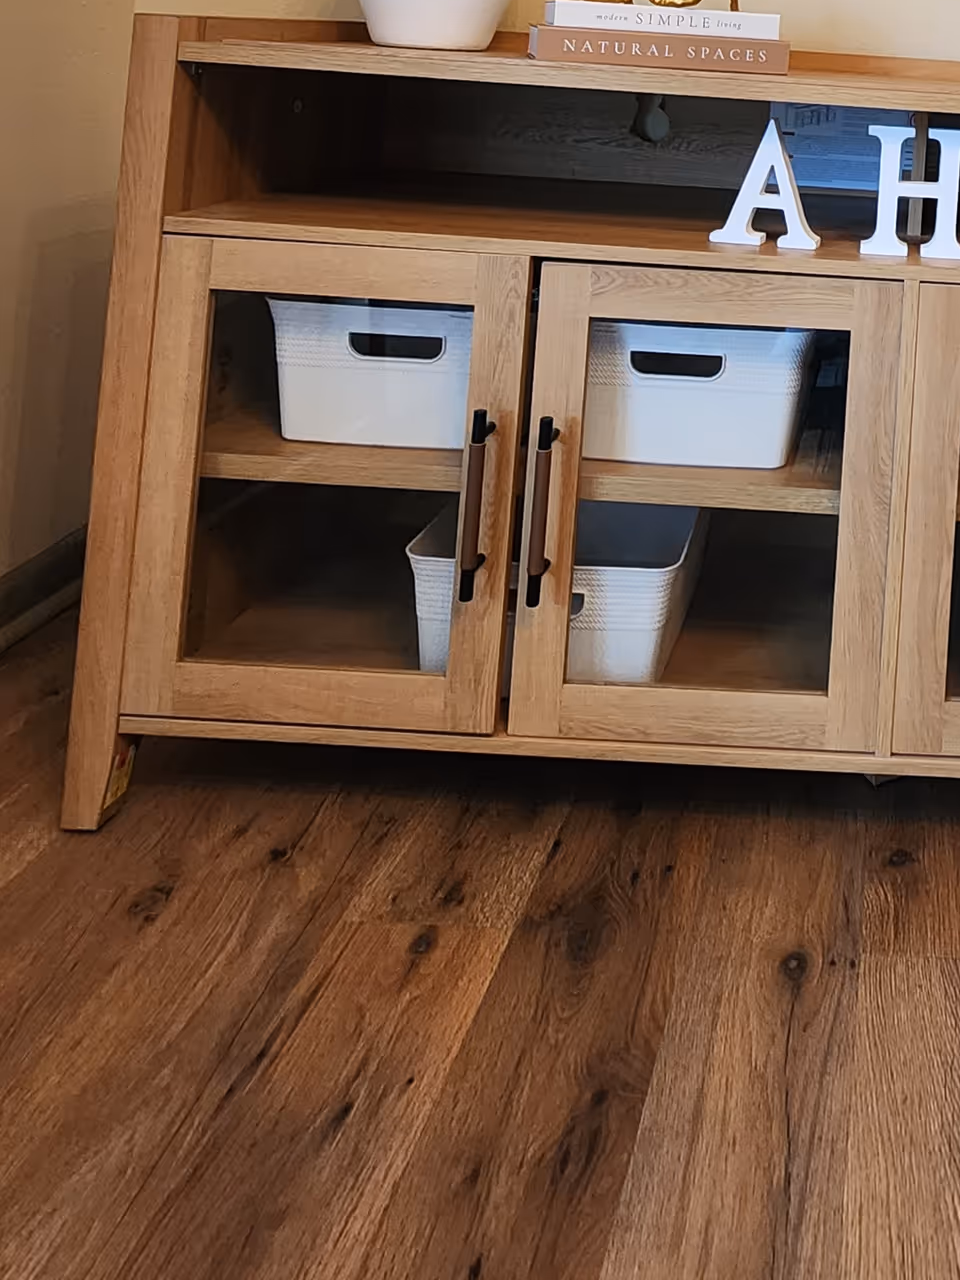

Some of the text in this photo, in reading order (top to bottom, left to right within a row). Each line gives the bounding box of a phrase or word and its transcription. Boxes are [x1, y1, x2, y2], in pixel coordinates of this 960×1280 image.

[596, 12, 743, 31] modern SIMPLE living
[562, 38, 769, 64] NATURAL SPACES
